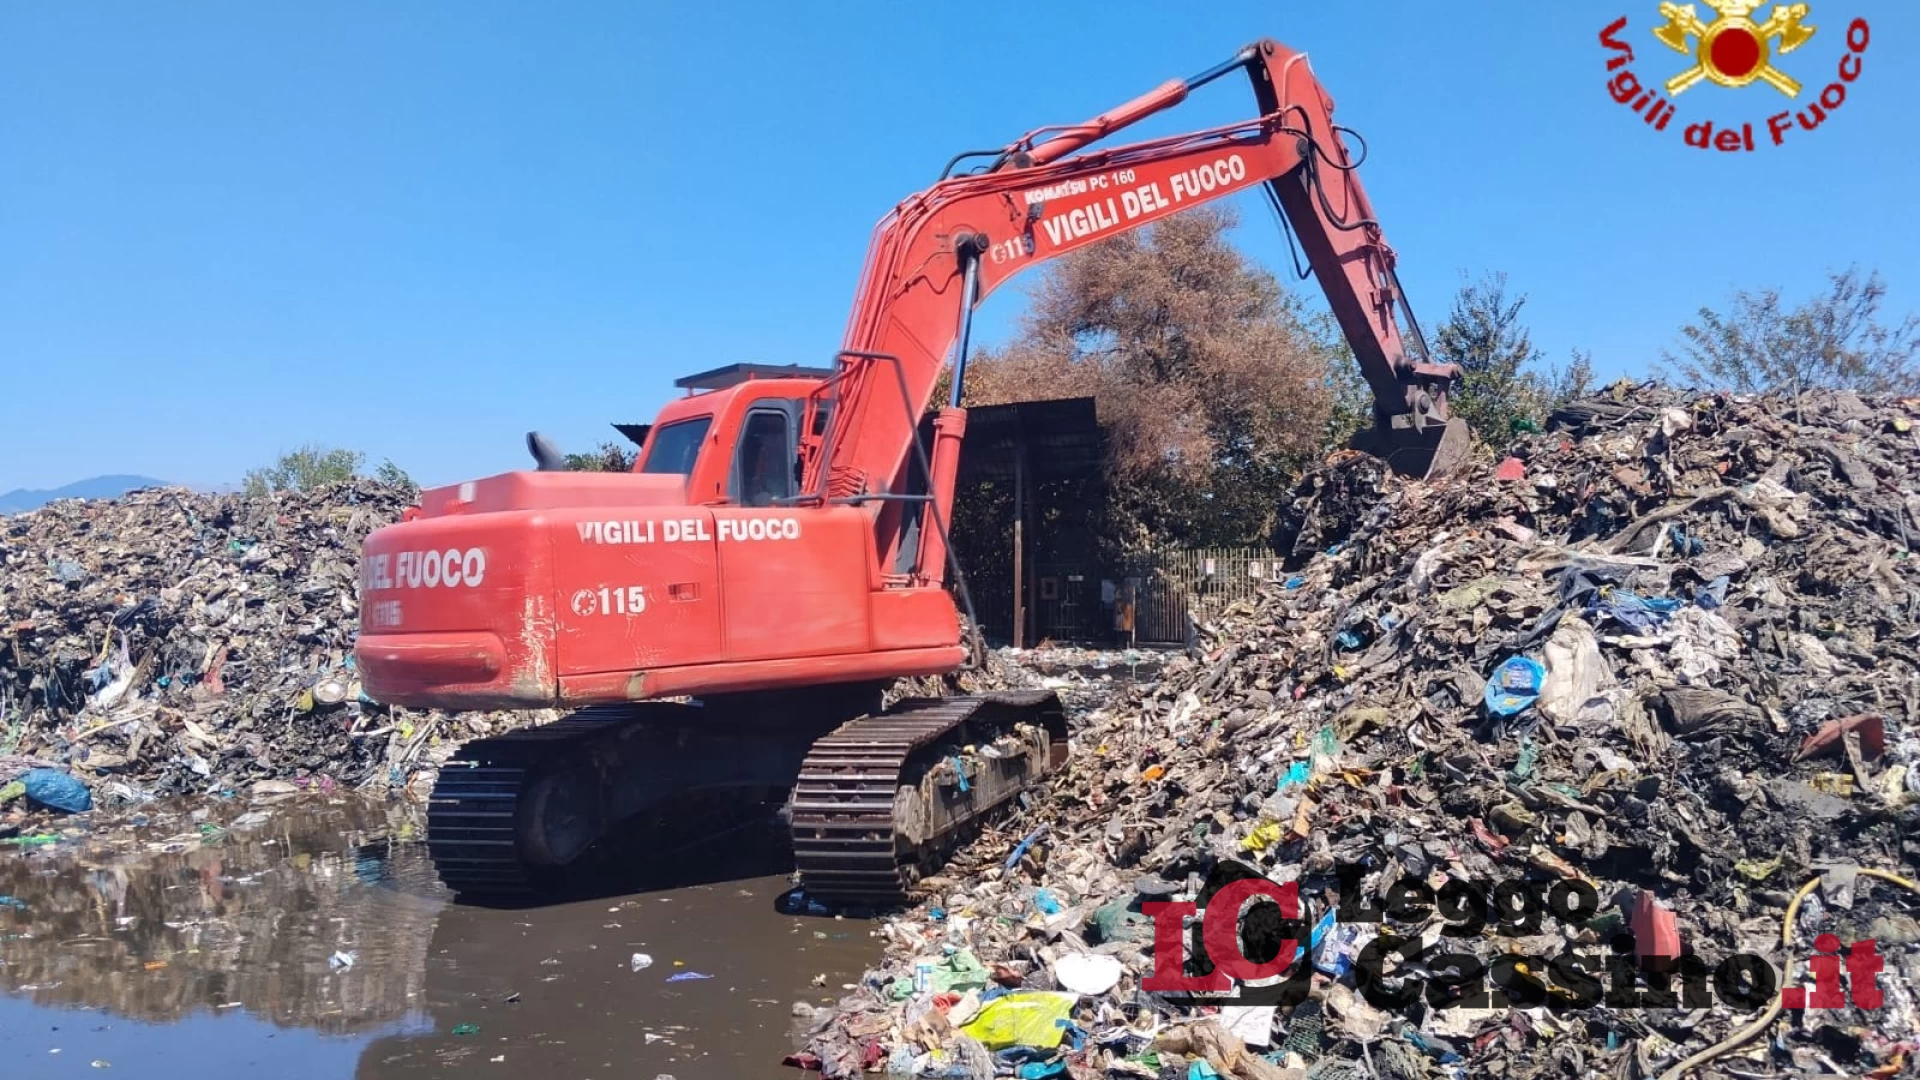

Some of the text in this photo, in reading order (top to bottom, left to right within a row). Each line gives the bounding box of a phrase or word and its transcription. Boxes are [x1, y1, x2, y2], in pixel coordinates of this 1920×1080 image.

[1024, 169, 1136, 204] KOMATSU PC 160
[1043, 154, 1246, 246] VIGILI DEL FUOCO
[576, 518, 801, 544] VIGILI DEL FUOCO
[395, 547, 486, 589] FUOCO
[598, 586, 646, 615] 115
